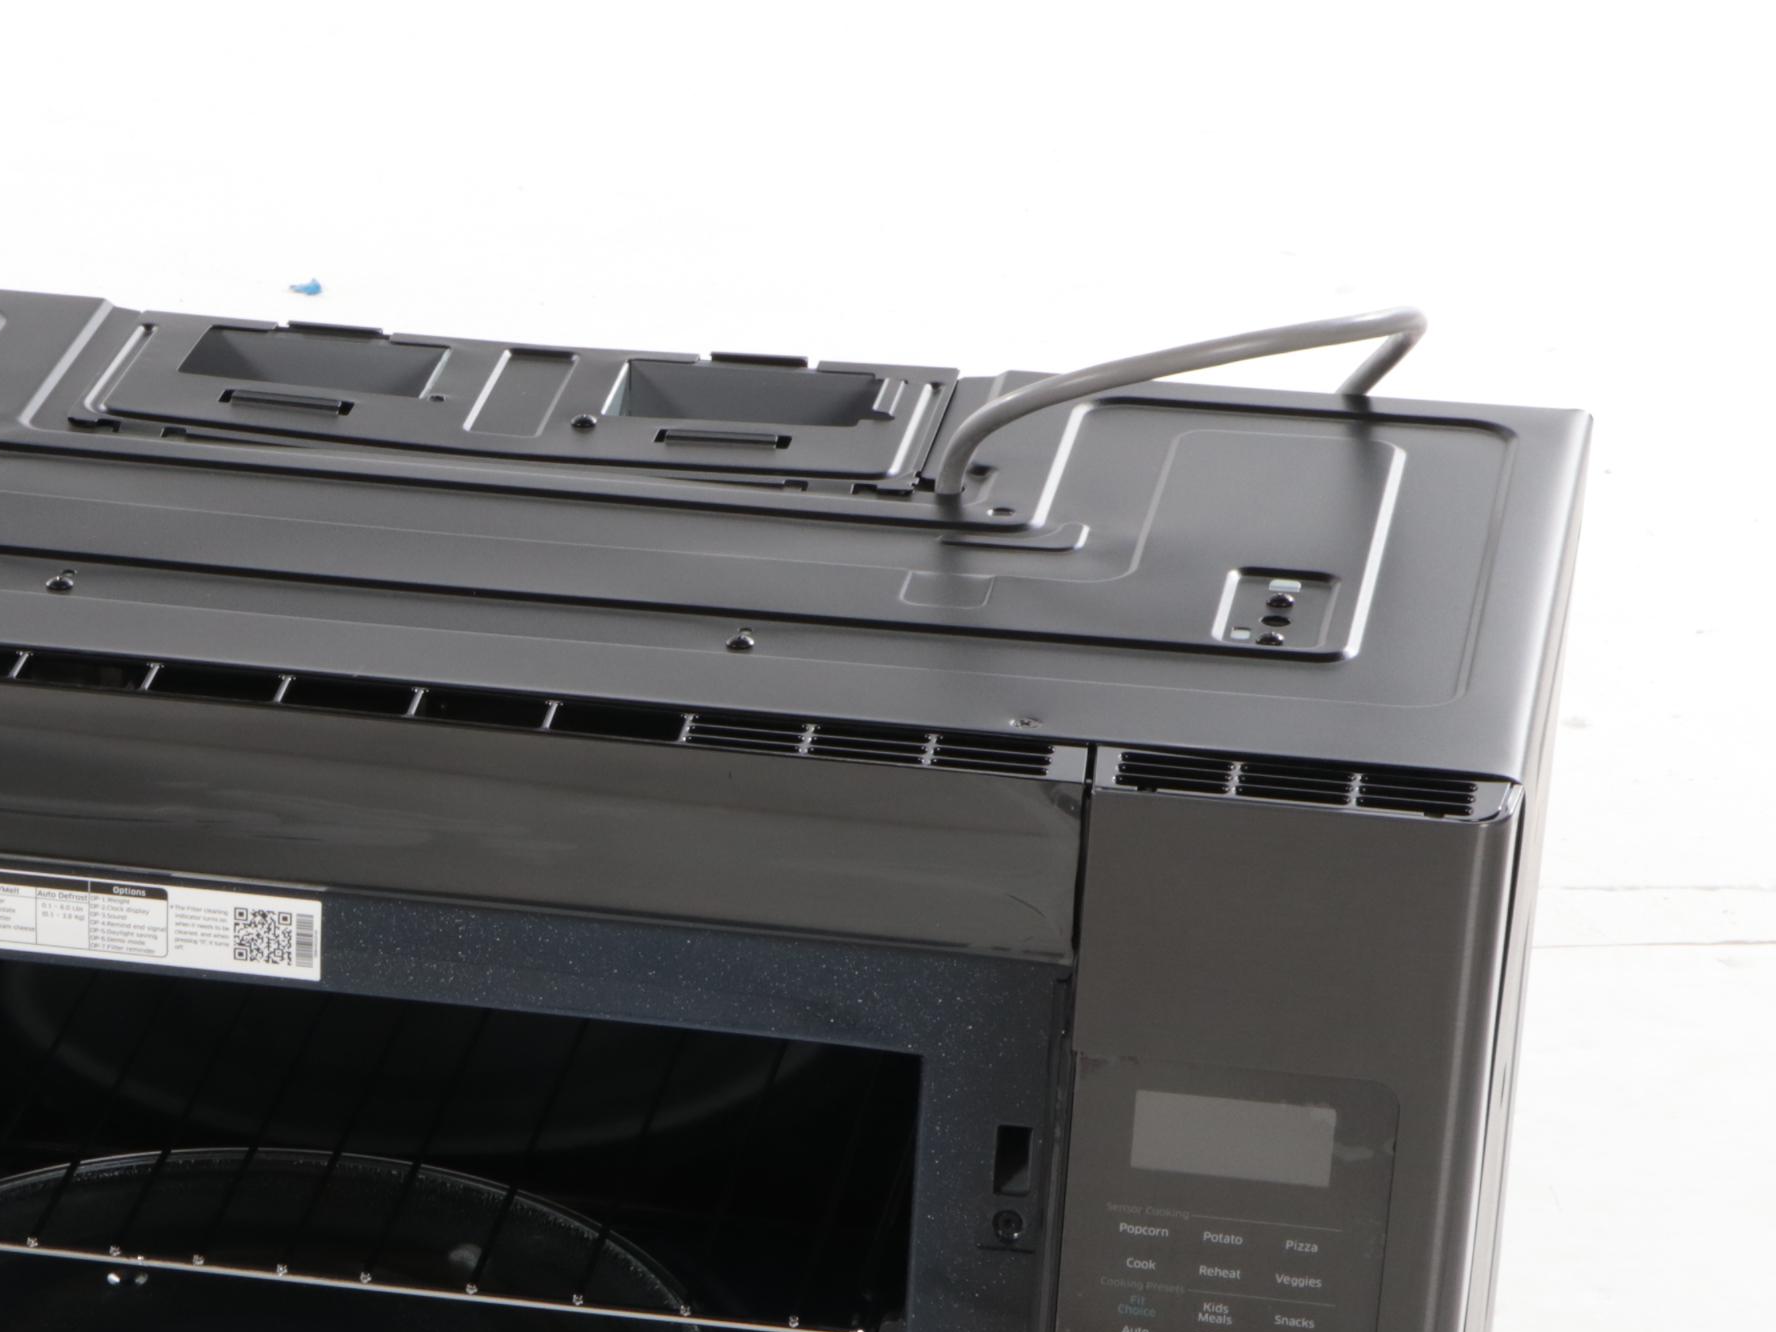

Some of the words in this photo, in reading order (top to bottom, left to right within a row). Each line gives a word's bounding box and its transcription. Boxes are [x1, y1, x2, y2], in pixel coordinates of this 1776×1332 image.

[58, 892, 87, 901] Defrost
[113, 885, 145, 897] Options
[1119, 1222, 1169, 1238] Popcorn
[1203, 1231, 1243, 1245] Potato
[1285, 1239, 1318, 1253] Pizza
[1126, 1257, 1156, 1271] Cook
[1199, 1265, 1241, 1279] Reheat
[1275, 1274, 1322, 1288] Veggies
[1118, 1303, 1156, 1317] Choice
[1203, 1302, 1229, 1314] Kids
[1198, 1313, 1233, 1325] Meals
[1274, 1315, 1315, 1329] Snacks
